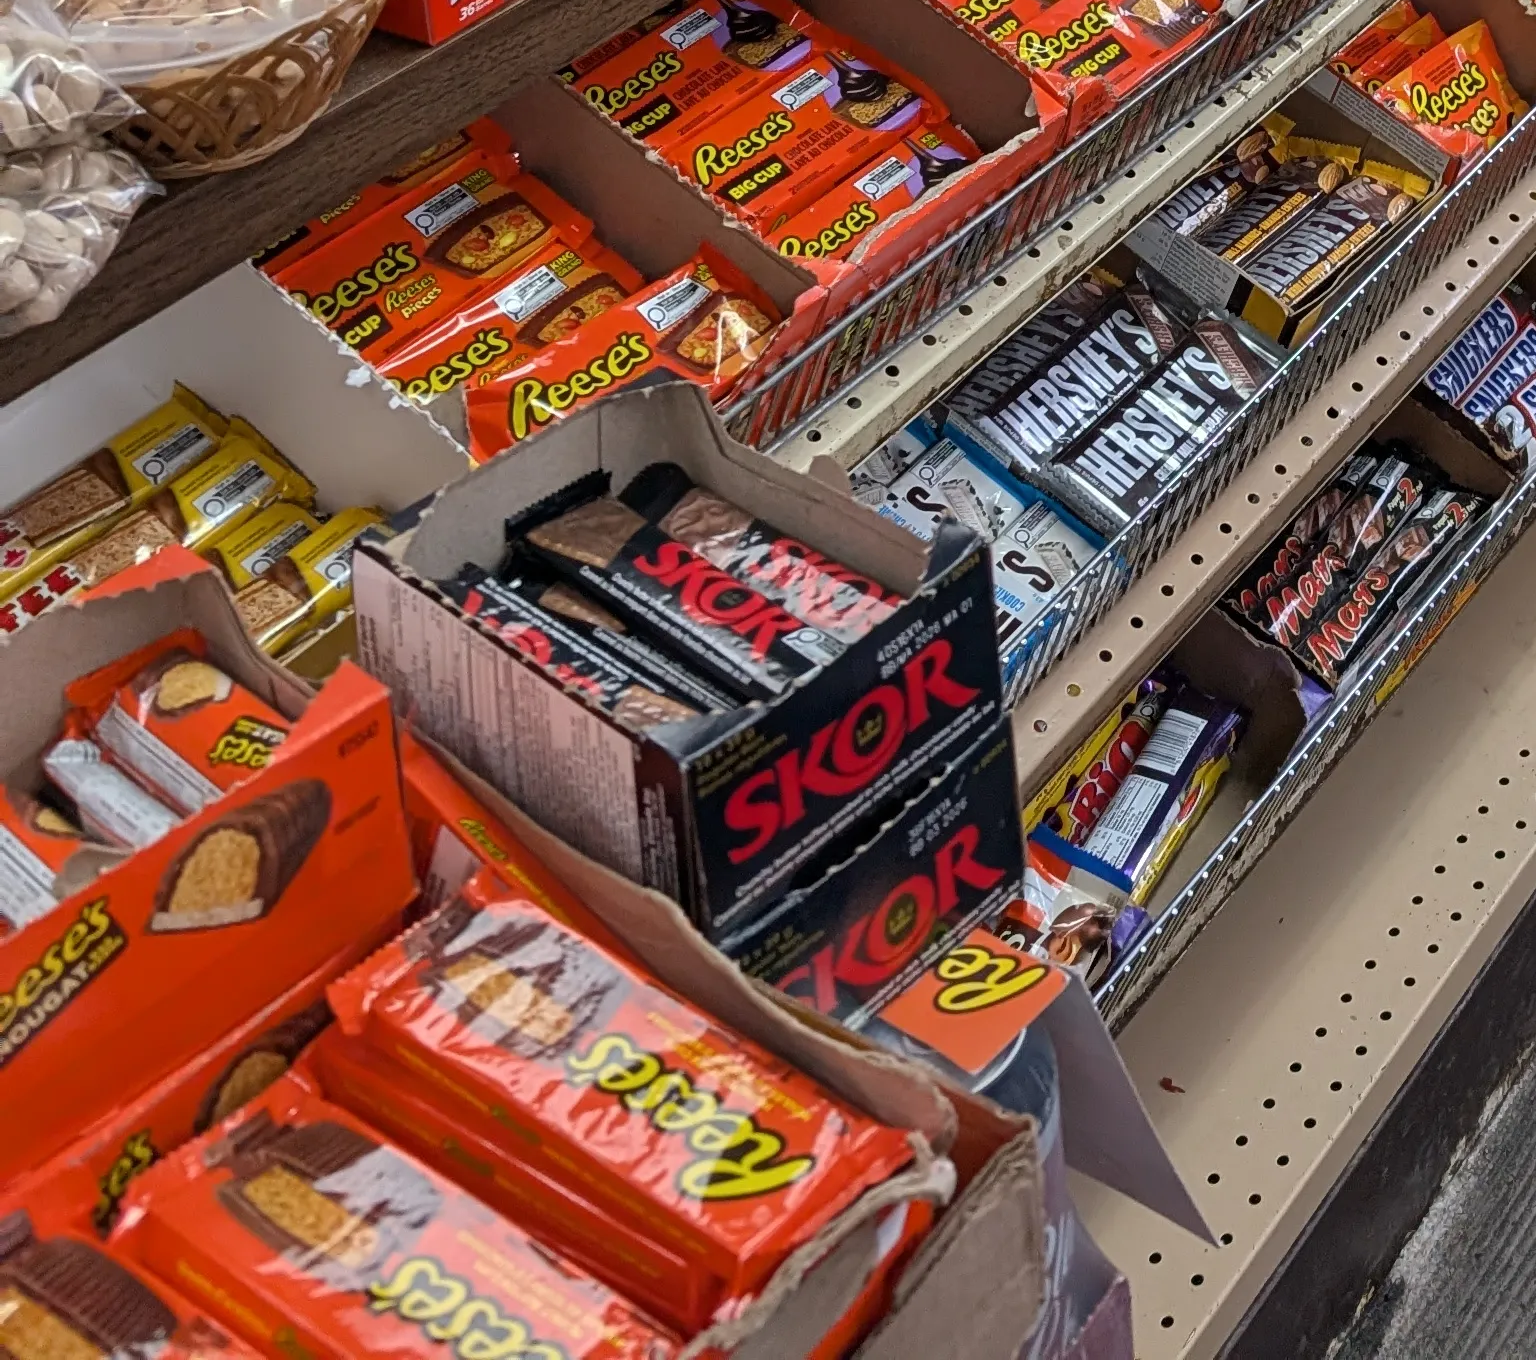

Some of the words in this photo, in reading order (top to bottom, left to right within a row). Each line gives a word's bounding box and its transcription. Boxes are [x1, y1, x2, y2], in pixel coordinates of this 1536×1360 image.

[584, 50, 684, 119] Reese's
[1016, 0, 1114, 71] Reese's
[1409, 61, 1491, 126] Reese's
[692, 110, 797, 186] Reese's
[726, 178, 758, 202] BIG
[751, 161, 785, 188] CUP
[509, 330, 654, 441] Reese's
[1000, 307, 1162, 458] HERSHEY'S
[1427, 298, 1521, 397] SNICKERS
[1075, 344, 1237, 496] HERSHEY'S
[634, 535, 800, 662] SKOR
[1307, 567, 1391, 671] Mars
[721, 637, 989, 868] SKOR
[567, 1028, 816, 1206] Reese's
